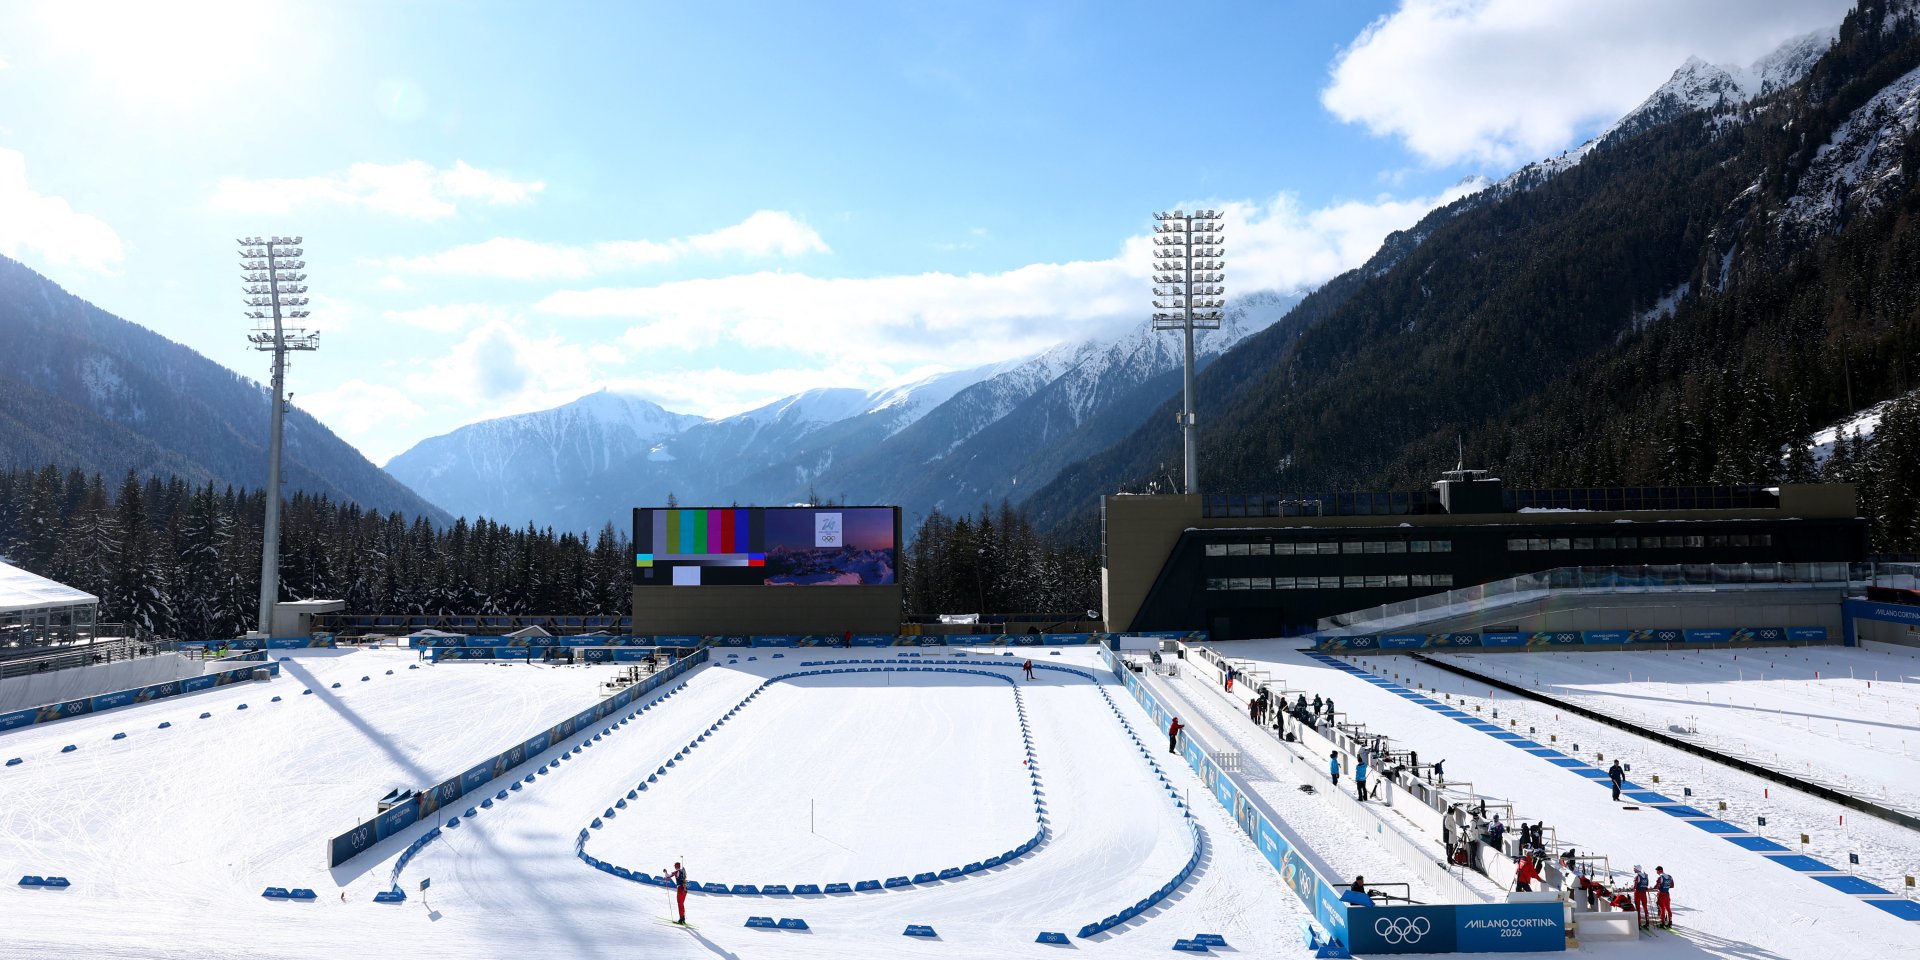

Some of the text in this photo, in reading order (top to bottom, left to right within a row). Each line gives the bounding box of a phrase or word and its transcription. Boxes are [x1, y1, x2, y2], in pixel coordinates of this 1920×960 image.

[1875, 609, 1897, 617] MILANO
[1464, 918, 1557, 929] MILANO CORTINA
[1500, 929, 1522, 937] 2026
